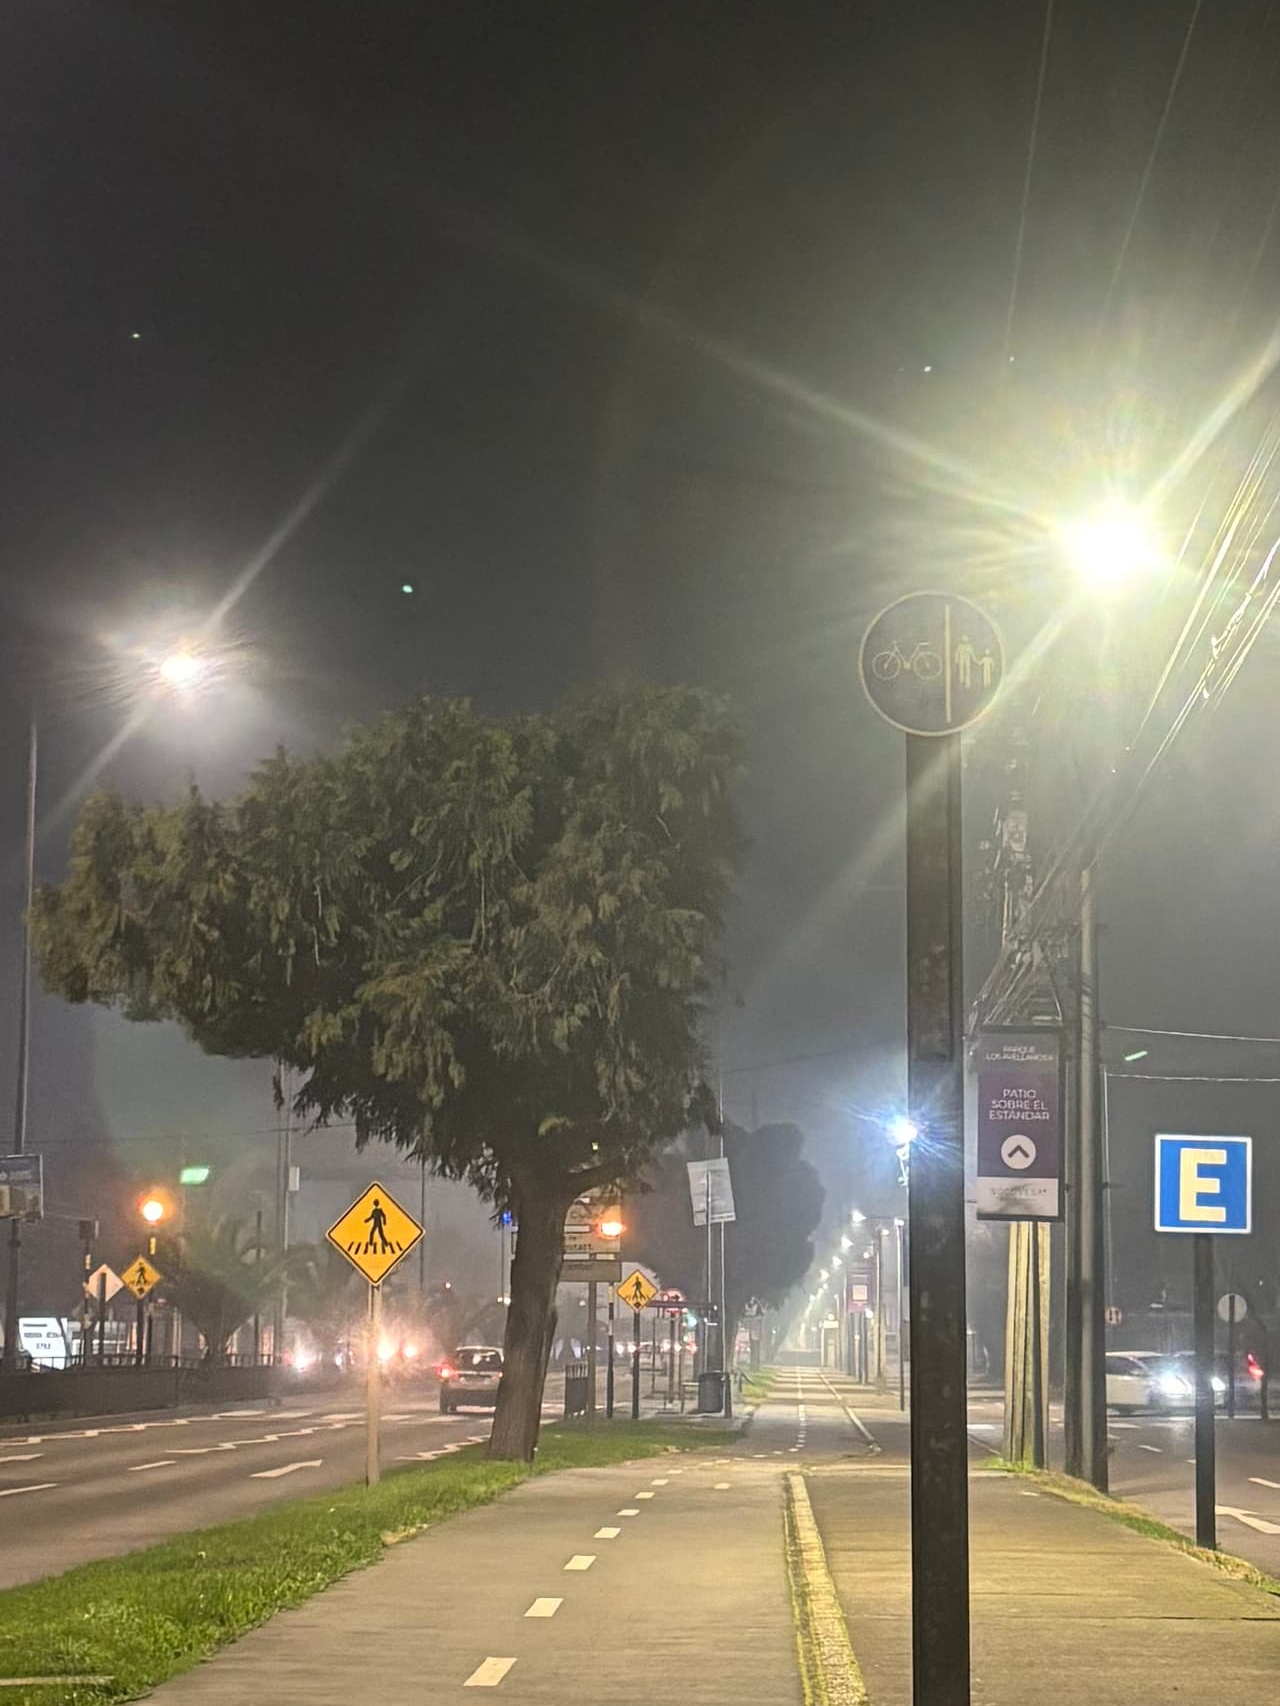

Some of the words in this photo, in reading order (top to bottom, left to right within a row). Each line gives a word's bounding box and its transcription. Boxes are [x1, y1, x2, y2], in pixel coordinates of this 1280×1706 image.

[1003, 1088, 1037, 1099] PATIO
[991, 1099, 1029, 1110] SOBRE
[1179, 1147, 1227, 1223] E
